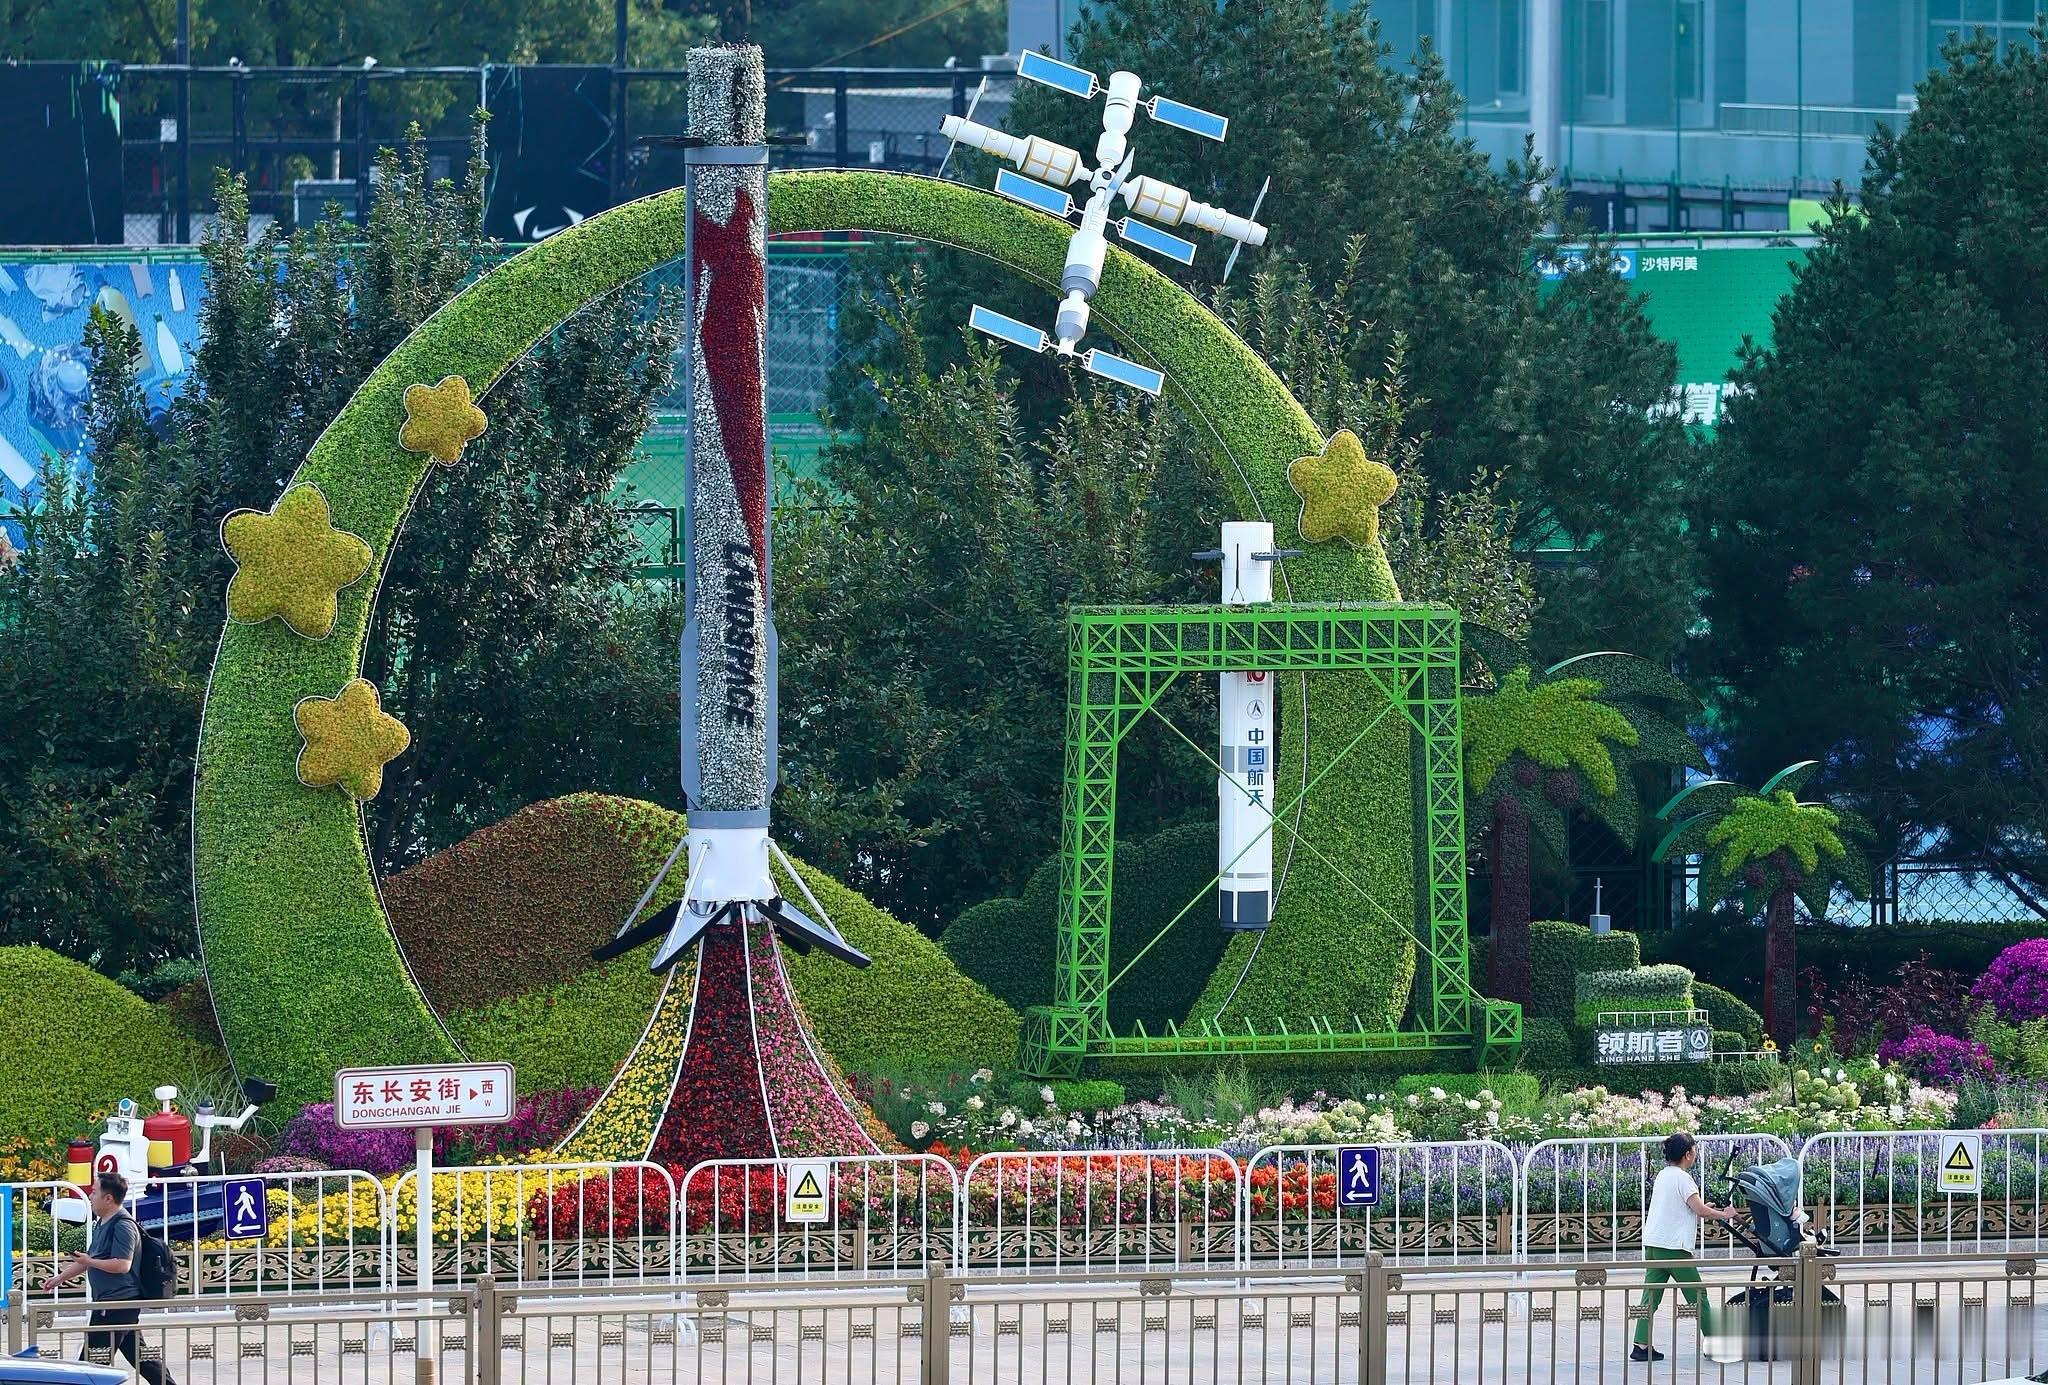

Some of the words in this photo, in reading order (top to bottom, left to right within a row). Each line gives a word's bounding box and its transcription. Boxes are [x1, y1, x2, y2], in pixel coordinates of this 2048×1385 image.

[1642, 256, 1698, 272] 沙特阿美
[724, 541, 756, 727] LANDSPACE
[1247, 727, 1265, 807] 中国航天
[1598, 1030, 1683, 1055] 领航者
[352, 1078, 461, 1105] 东长安街
[480, 1079, 494, 1094] 西
[445, 1104, 462, 1114] JIE
[484, 1099, 492, 1107] W
